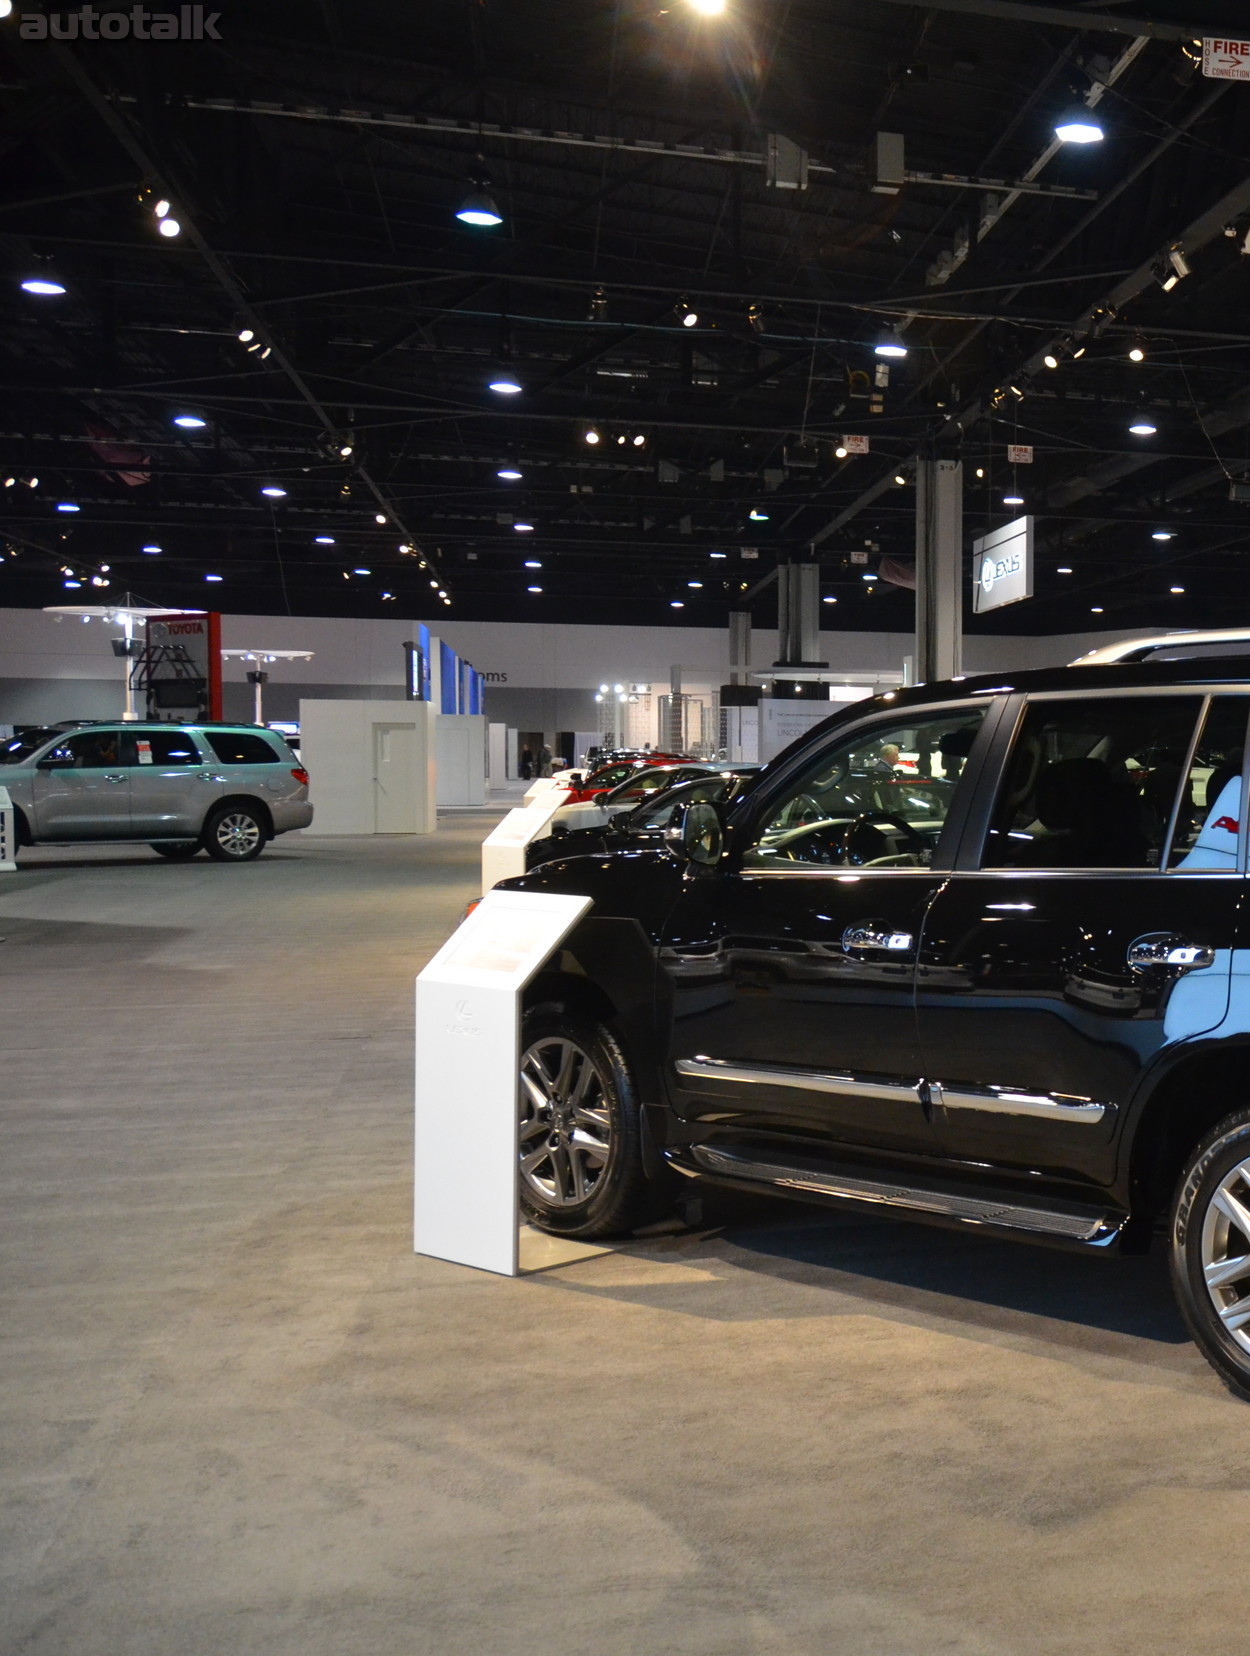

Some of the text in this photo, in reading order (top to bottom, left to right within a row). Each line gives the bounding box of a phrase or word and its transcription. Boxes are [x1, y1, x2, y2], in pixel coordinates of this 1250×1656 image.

[1213, 40, 1250, 56] FIRE
[1211, 68, 1250, 78] CONNECTION
[992, 554, 1022, 580] LEXUS
[167, 622, 204, 636] TOYOTA
